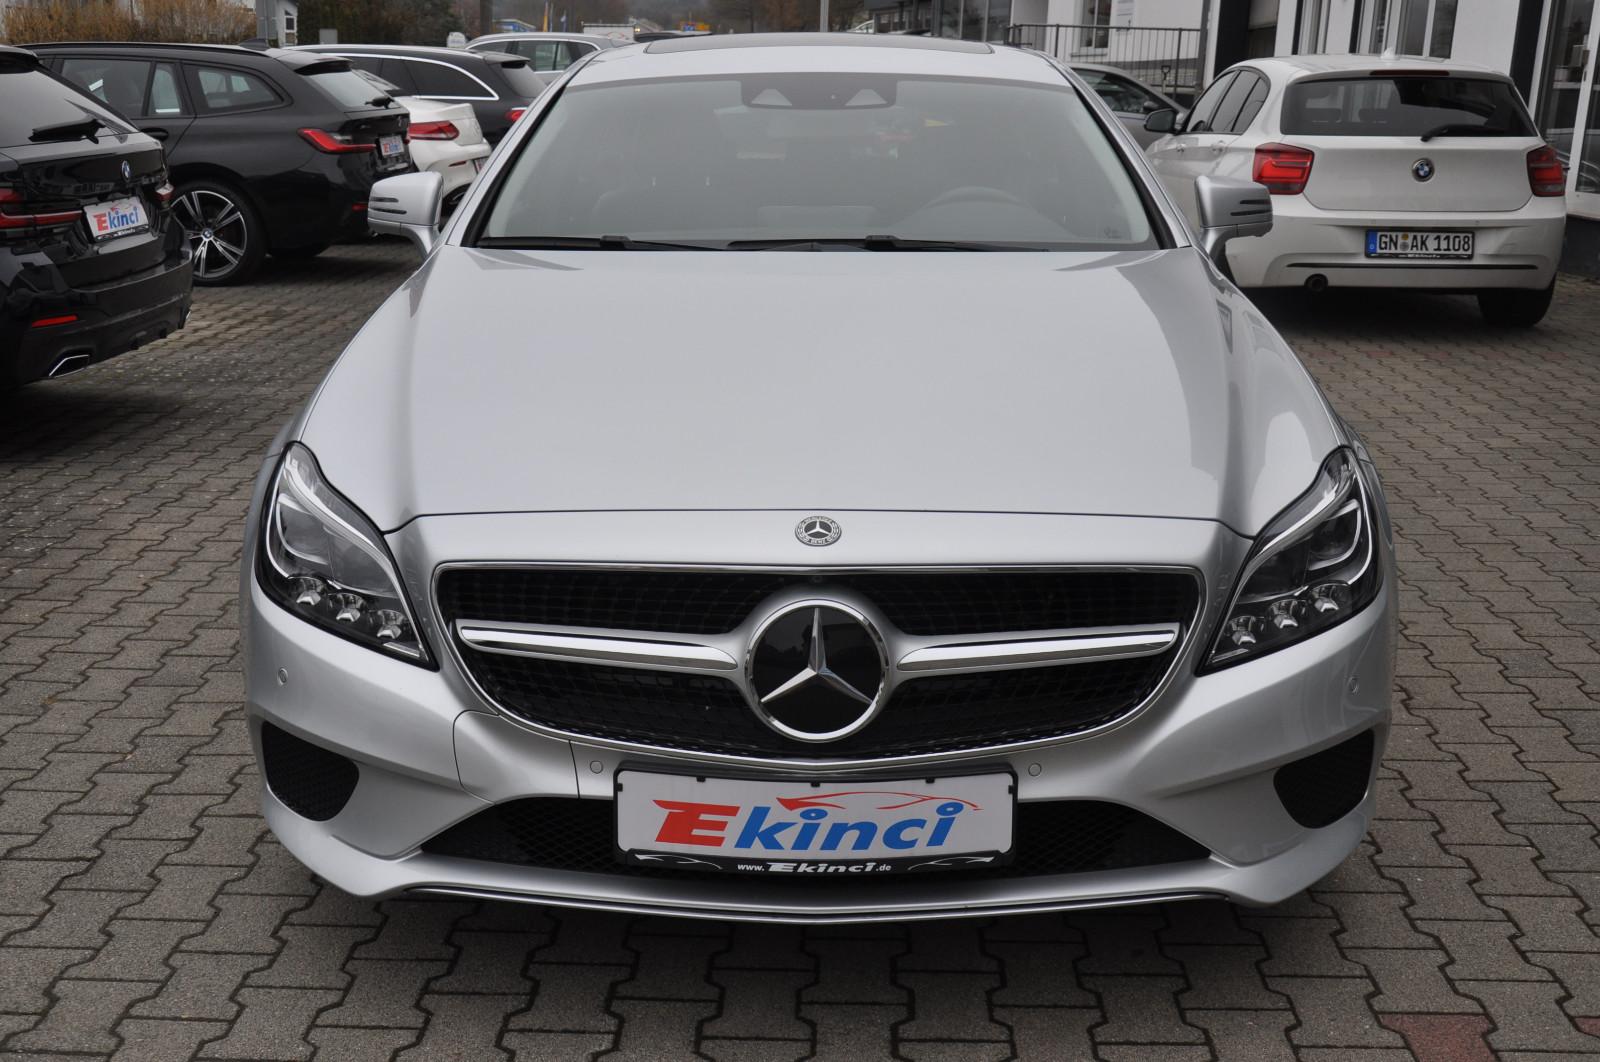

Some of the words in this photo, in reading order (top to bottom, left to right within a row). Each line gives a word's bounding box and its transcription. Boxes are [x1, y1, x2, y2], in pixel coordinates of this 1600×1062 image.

[93, 206, 139, 231] Ekinci
[1378, 234, 1399, 251] GN
[1410, 234, 1429, 251] AK
[1433, 235, 1471, 252] 1108
[653, 799, 964, 851] Ekinci
[737, 862, 892, 873] www.Ekinci.de
